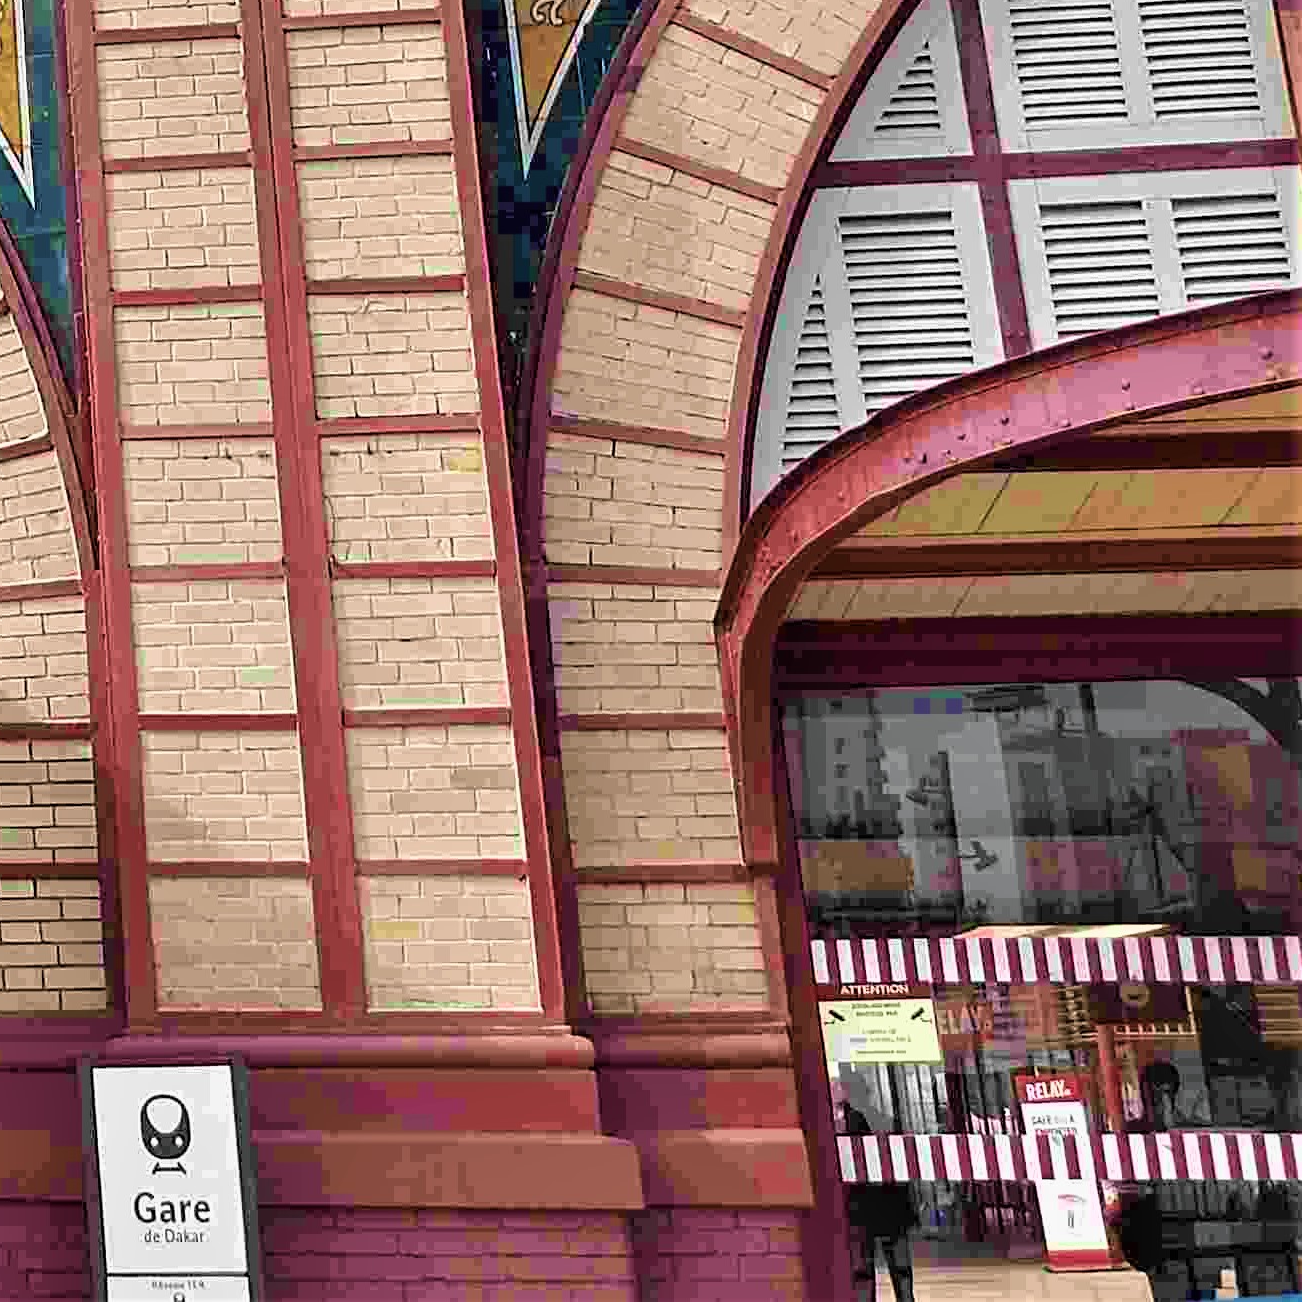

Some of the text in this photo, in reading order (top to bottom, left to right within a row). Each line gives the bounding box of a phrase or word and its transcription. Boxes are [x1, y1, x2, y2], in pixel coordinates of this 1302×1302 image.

[840, 984, 909, 995] ATTENTION
[1025, 1079, 1065, 1101] RELAY
[134, 1191, 211, 1224] Gare
[144, 1228, 205, 1243] de Dakar
